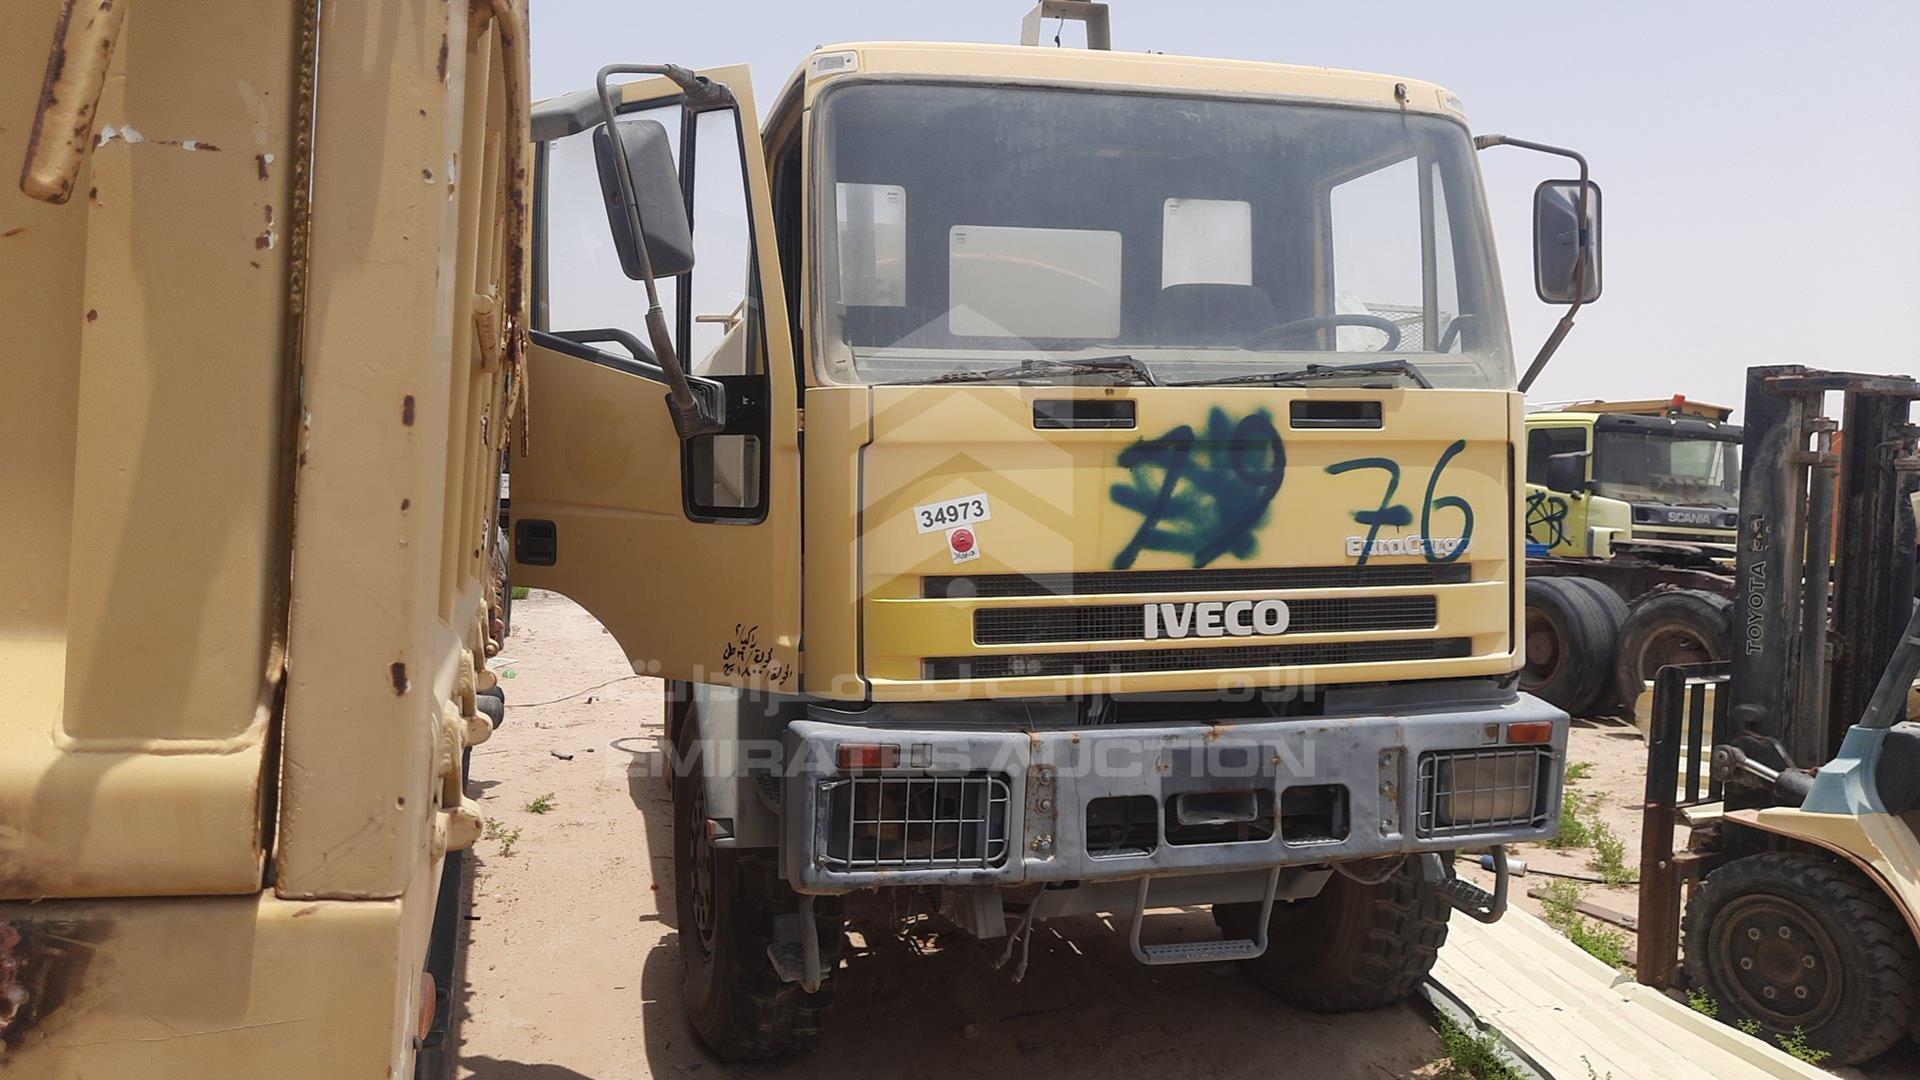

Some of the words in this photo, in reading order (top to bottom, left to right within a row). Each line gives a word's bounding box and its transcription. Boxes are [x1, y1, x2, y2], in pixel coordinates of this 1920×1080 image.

[921, 500, 984, 528] 34973
[1325, 439, 1474, 566] 76
[1668, 511, 1711, 524] SCANIA
[1144, 600, 1290, 639] IVECO
[1745, 560, 1767, 656] TOYOTA
